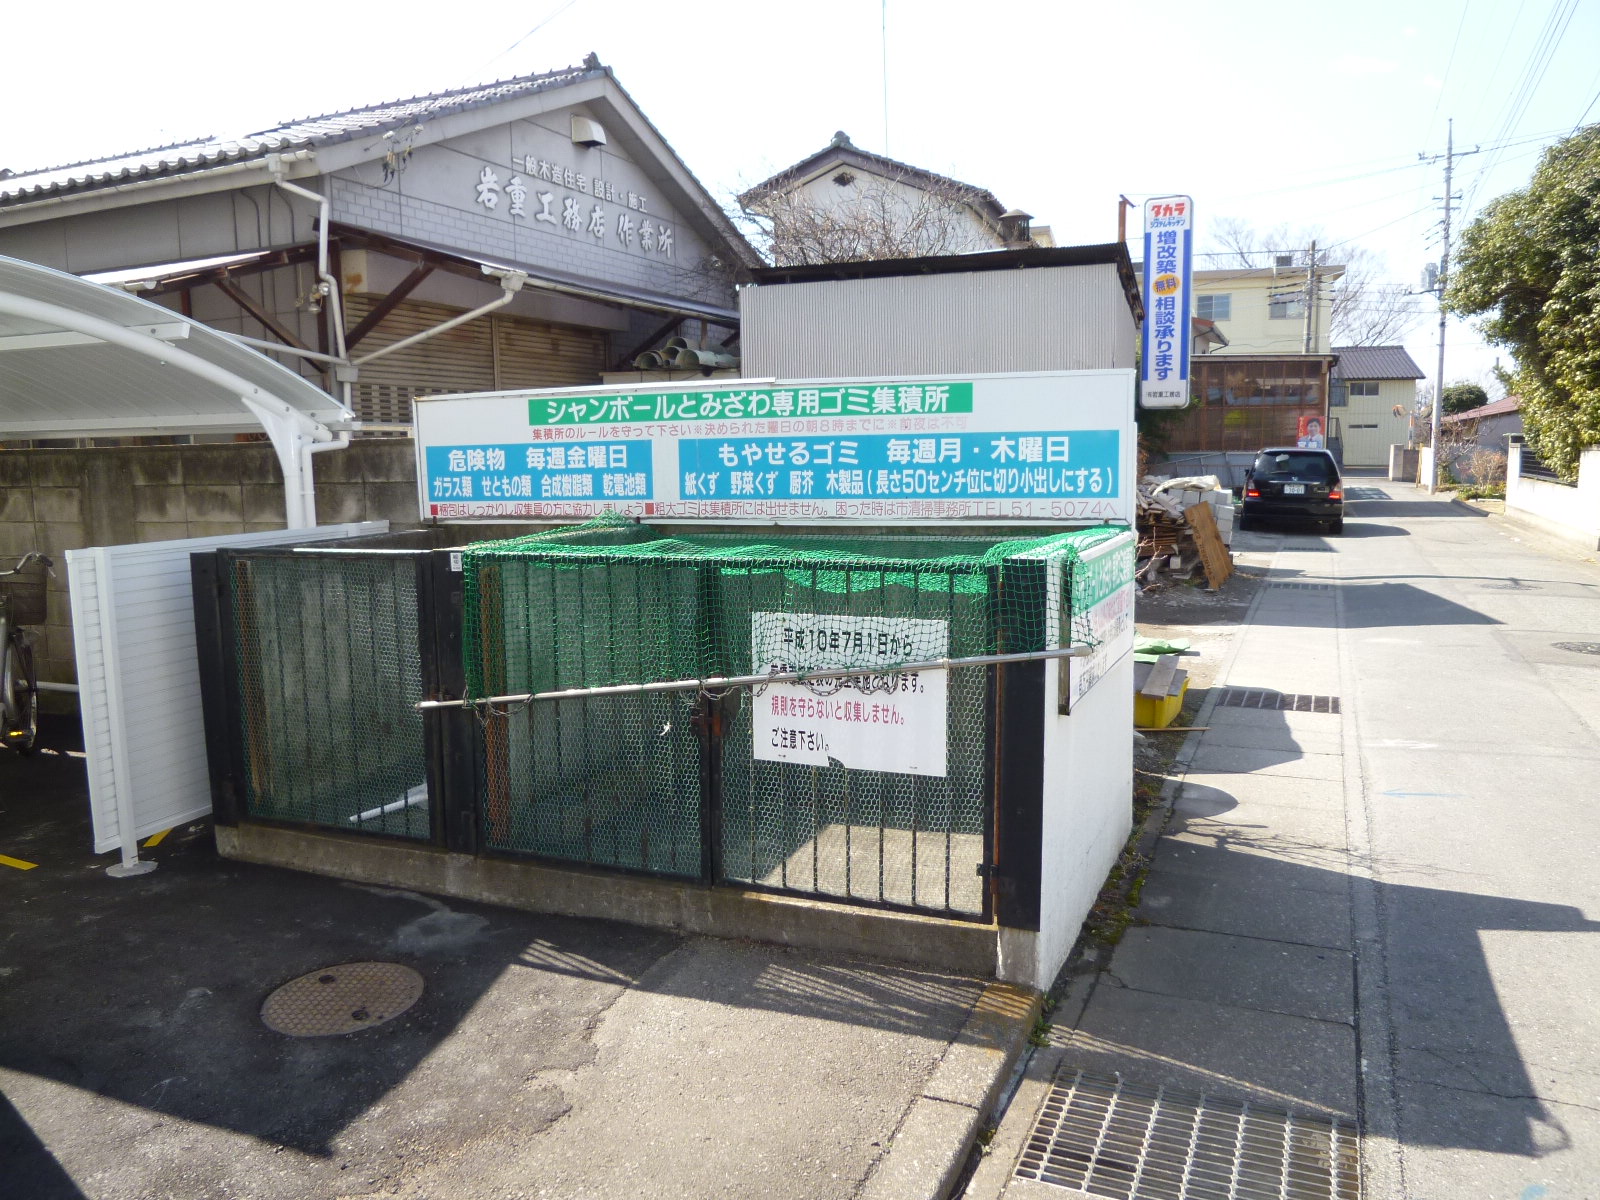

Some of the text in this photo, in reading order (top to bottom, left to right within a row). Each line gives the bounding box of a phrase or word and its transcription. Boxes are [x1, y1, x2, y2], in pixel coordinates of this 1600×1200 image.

[512, 154, 648, 213] 一般木造住宅 設計・施工
[476, 166, 673, 259] 岩重工務店 作業所
[1151, 202, 1186, 217] タカラ
[1151, 219, 1185, 229] システムキッチン
[1155, 230, 1177, 380] 増改築 無料 相談承ります
[547, 385, 950, 423] シャンボールとみざわ専用ゴミ集積所
[448, 445, 627, 472] 危険物 毎週金曜日
[718, 436, 1069, 467] もやせるゴミ 毎週月・木曜日
[433, 473, 647, 498] ガラス類 せともの類 合成樹脂類 乾電池類
[685, 472, 720, 496] 紙くず
[730, 470, 779, 495] 野菜くず
[789, 470, 814, 495] 厨芥
[783, 628, 912, 656] 平成10年7月1日から
[771, 695, 904, 724] 規則を守らないと収集しません。
[772, 726, 830, 752] ご注意下さい。
